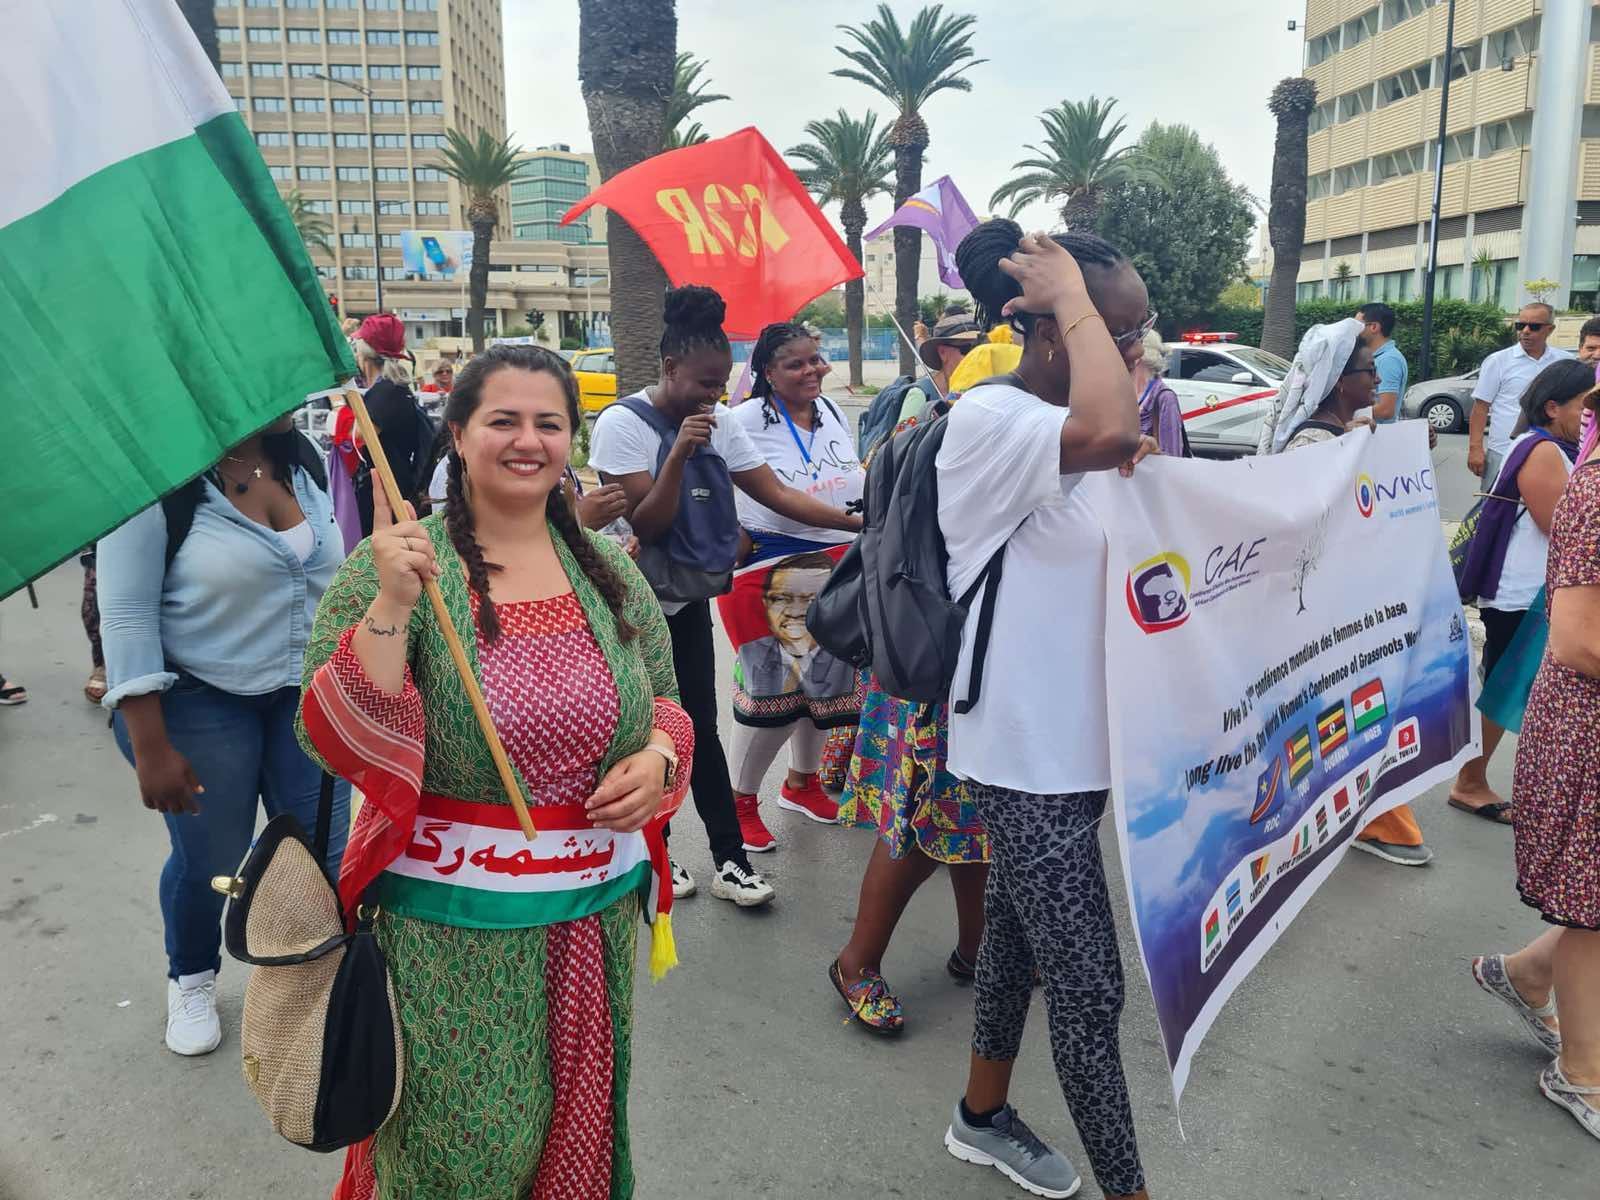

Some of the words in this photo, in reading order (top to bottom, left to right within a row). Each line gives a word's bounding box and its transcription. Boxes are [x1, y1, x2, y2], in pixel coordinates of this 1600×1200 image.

[1205, 537, 1267, 585] CAF
[1215, 754, 1243, 776] live
[1243, 741, 1257, 765] the
[1308, 666, 1349, 700] Conference
[1350, 655, 1358, 674] of
[1358, 637, 1404, 669] Grassroots
[1223, 707, 1241, 733] Vive
[1240, 698, 1248, 719] la
[1289, 640, 1320, 672] mondiale
[1320, 633, 1333, 651] des
[1333, 619, 1363, 645] femmes
[1363, 613, 1375, 630] de
[1375, 609, 1385, 624] la
[1385, 601, 1408, 620] base
[1264, 814, 1280, 833] RDC
